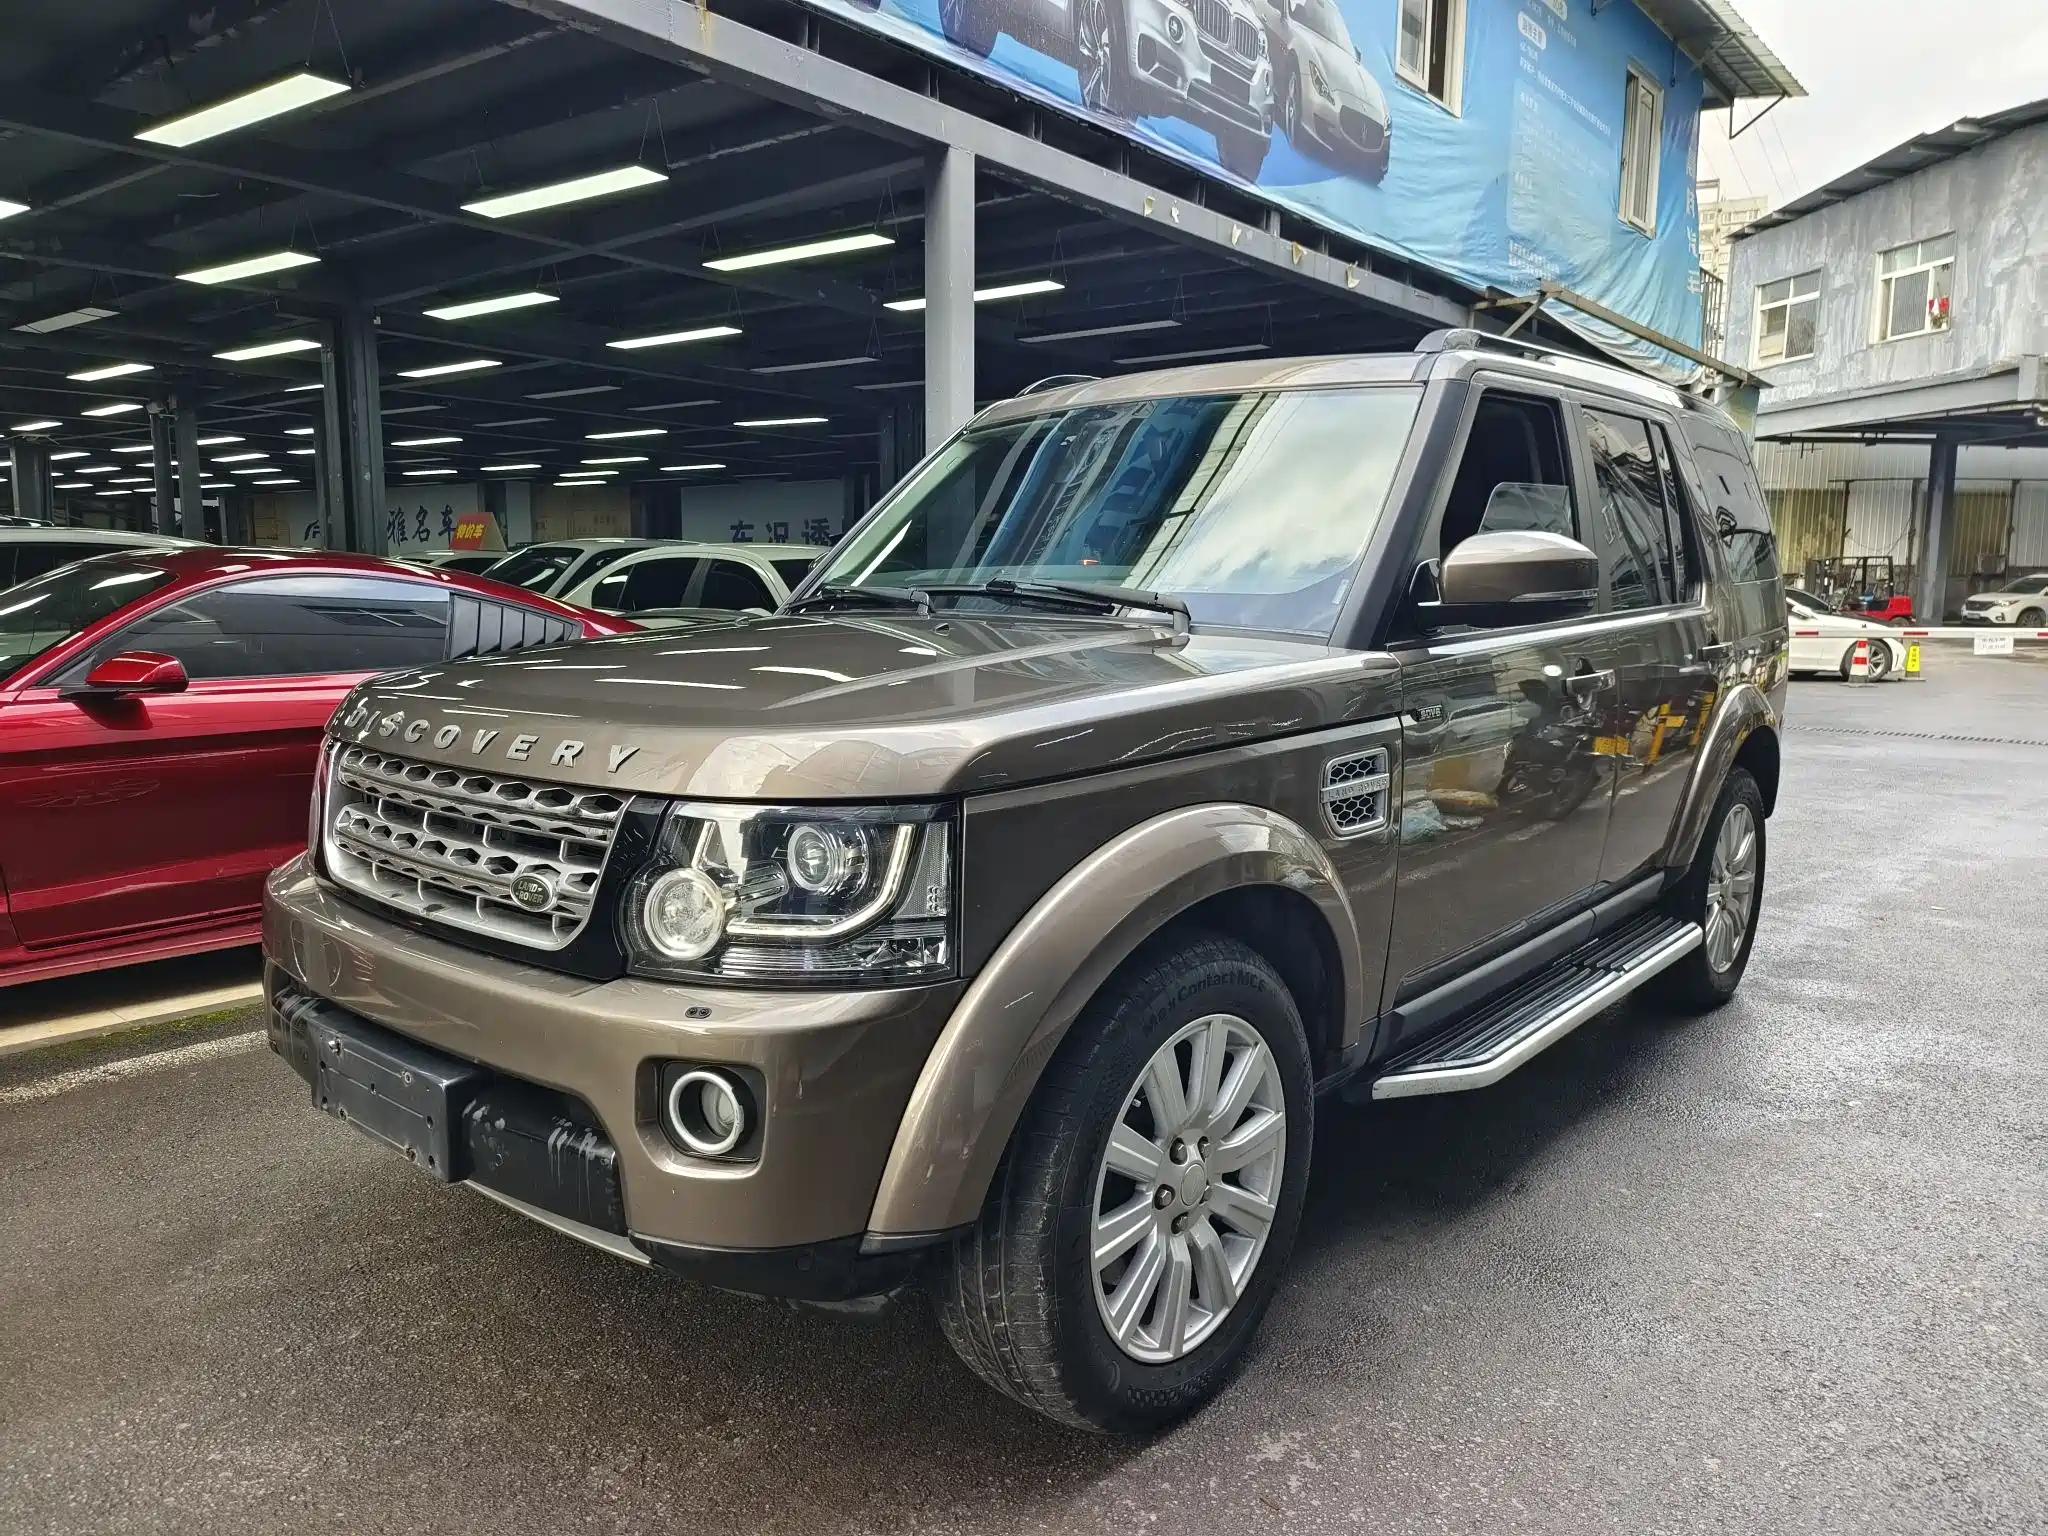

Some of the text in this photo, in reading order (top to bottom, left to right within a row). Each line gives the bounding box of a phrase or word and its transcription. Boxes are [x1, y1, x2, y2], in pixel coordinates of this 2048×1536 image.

[456, 522, 485, 539] 特价车
[346, 705, 640, 773] DISCOVERY
[1328, 787, 1355, 799] LAND
[518, 881, 538, 892] LAND
[519, 890, 544, 903] ROVER
